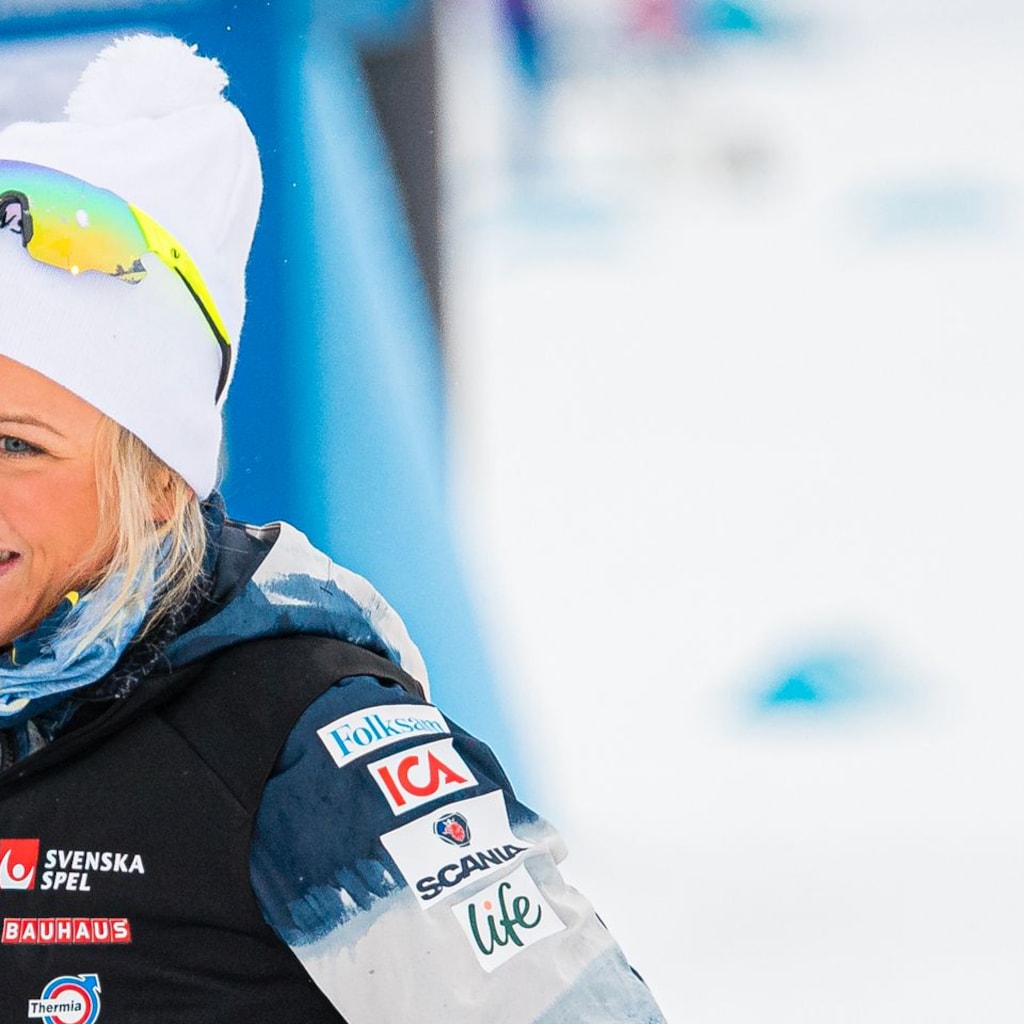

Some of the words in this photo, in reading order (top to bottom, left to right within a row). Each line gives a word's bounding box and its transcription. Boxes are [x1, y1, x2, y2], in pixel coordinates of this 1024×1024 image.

[329, 714, 443, 759] Folksam
[377, 749, 469, 808] ICA
[44, 849, 146, 875] SVENSKA
[415, 844, 531, 901] SCANIA
[39, 871, 91, 892] SPEL
[4, 919, 129, 941] BAUHAUS
[468, 881, 543, 956] life
[29, 1000, 82, 1015] Thermia
